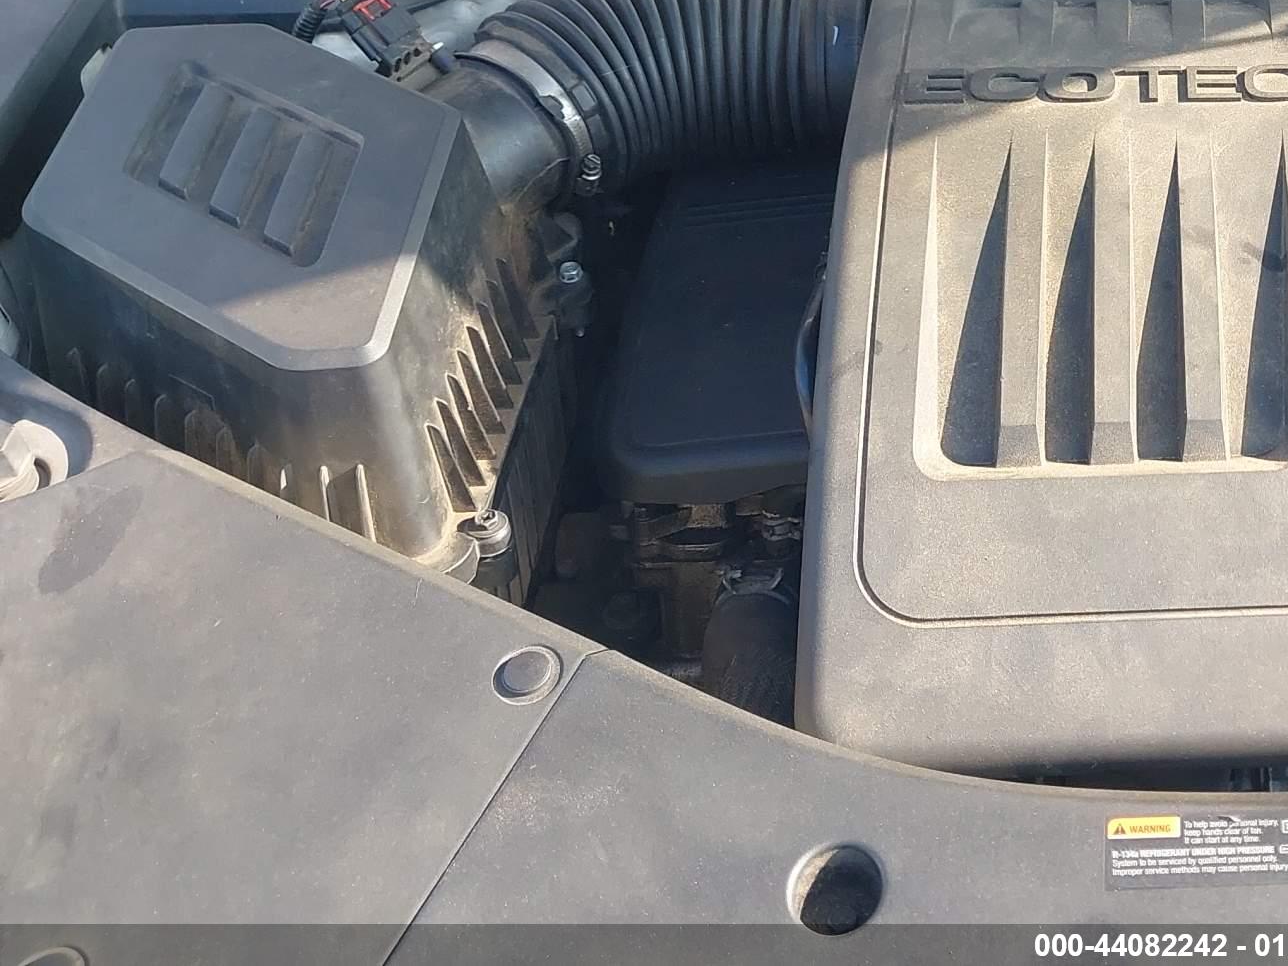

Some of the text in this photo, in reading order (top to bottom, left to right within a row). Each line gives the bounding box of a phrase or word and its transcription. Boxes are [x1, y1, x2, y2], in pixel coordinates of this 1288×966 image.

[1129, 824, 1171, 834] WARNING
[1193, 820, 1208, 829] help
[1190, 837, 1203, 845] can
